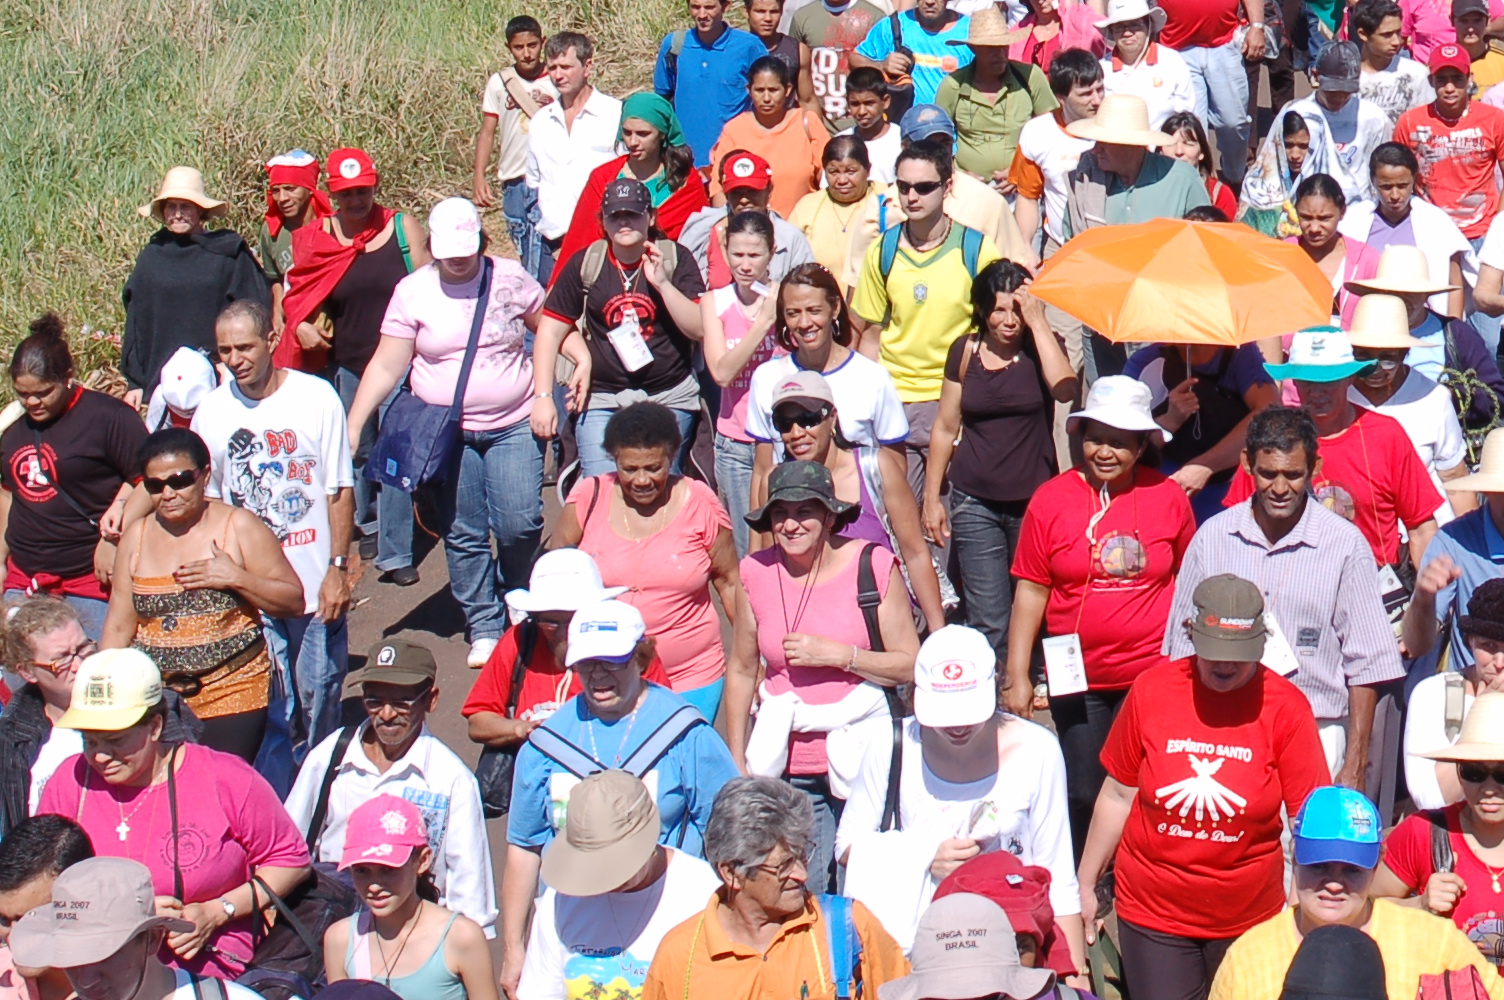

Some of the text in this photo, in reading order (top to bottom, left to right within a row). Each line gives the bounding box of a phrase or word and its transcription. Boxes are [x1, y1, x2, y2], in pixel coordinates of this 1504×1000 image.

[264, 429, 298, 458] BAD
[286, 459, 317, 485] BOY
[1166, 737, 1253, 763] ESPÍRITO SANTO
[1194, 829, 1209, 840] de
[70, 900, 90, 909] 2007
[967, 928, 988, 937] 2007
